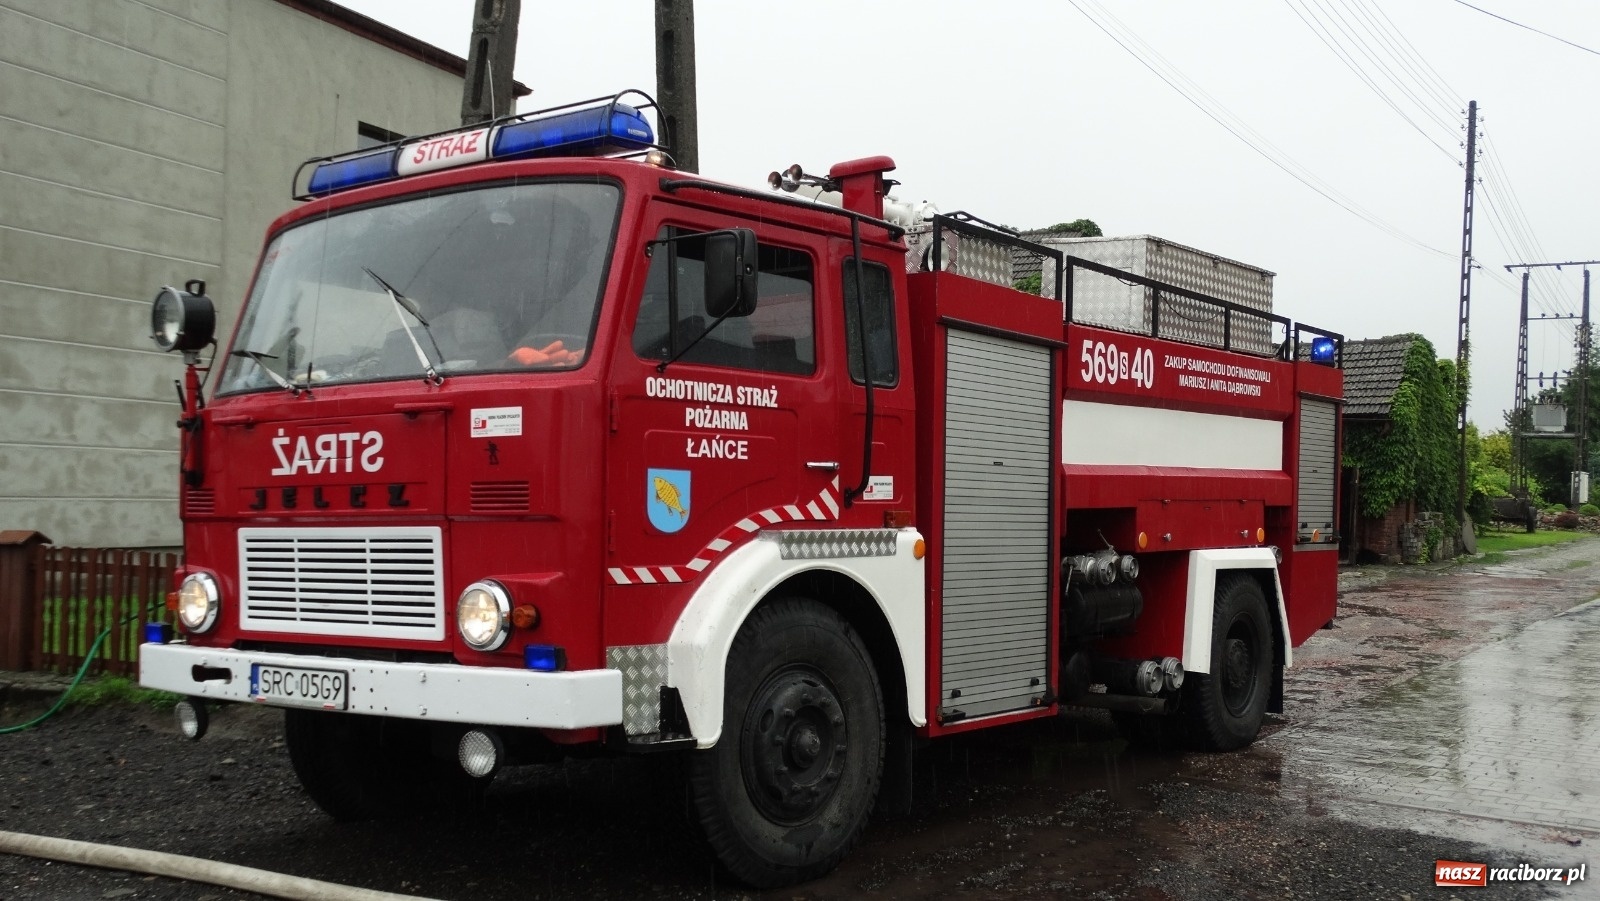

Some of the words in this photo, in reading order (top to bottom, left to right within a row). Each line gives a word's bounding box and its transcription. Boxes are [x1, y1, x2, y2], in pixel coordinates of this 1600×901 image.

[1164, 355, 1187, 370] ZAKUP
[1188, 359, 1226, 376] SAMOCHODU
[1226, 366, 1271, 383] DOFINANSOWALI
[645, 376, 734, 404] OCHOTNICZA
[736, 385, 779, 408] STRAŻ
[1179, 374, 1207, 390] MARIUSZ
[1210, 379, 1227, 392] ANITA
[1227, 381, 1261, 397] DĄBROWSKI
[685, 405, 749, 431] POŻARNA
[686, 435, 749, 460] ŁAŃCE
[262, 669, 294, 696] SRC
[300, 673, 342, 701] 05G9
